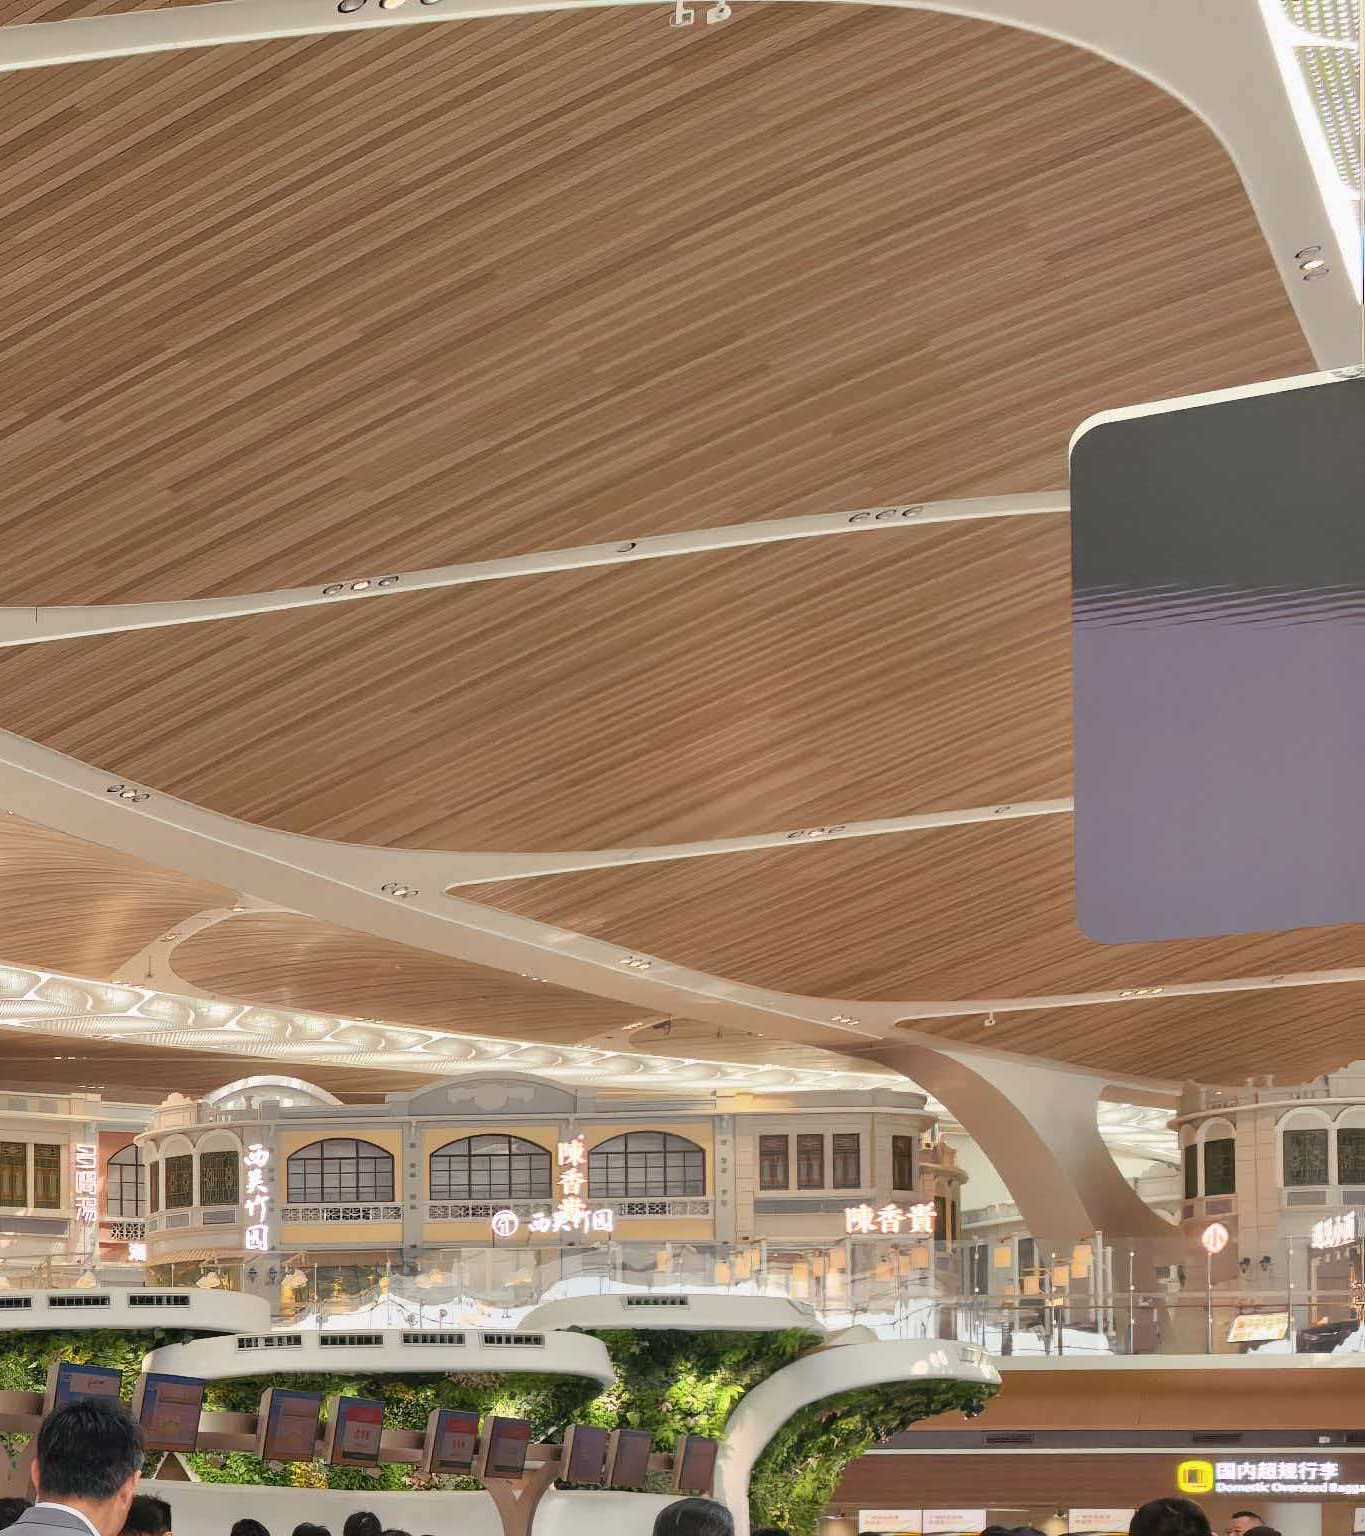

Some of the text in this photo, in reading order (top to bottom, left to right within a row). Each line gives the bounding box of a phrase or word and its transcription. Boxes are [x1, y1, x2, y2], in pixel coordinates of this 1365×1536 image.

[1214, 1461, 1339, 1481] 国内超规行李
